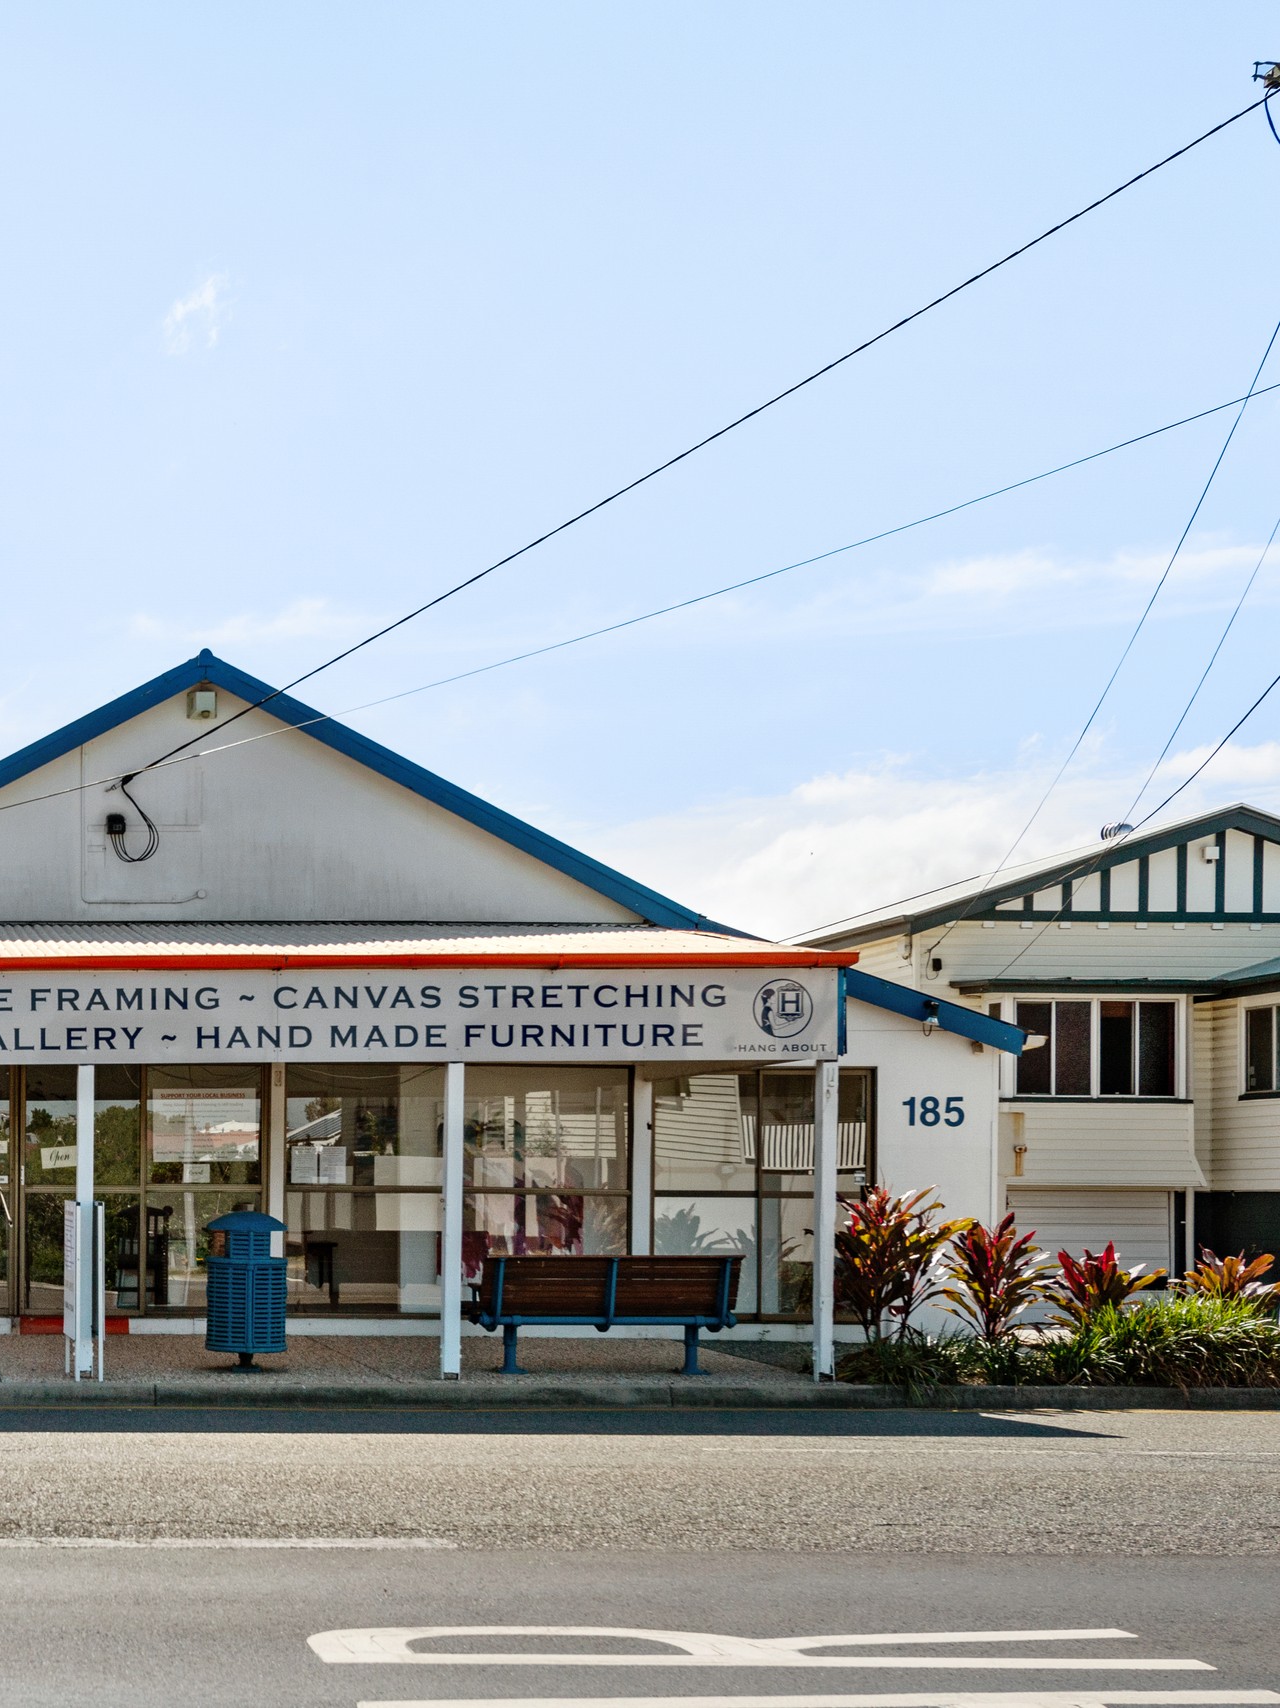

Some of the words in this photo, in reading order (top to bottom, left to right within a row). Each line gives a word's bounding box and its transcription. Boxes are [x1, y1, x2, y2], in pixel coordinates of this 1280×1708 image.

[30, 986, 220, 1012] FRAMING
[273, 985, 442, 1010] CANVAS
[458, 983, 727, 1009] STRETCHING
[196, 1025, 313, 1049] HAND
[330, 1024, 447, 1048] MADE
[464, 1023, 704, 1048] FURNITURE
[738, 1044, 777, 1053] HANG
[781, 1043, 827, 1053] ABOUT
[901, 1095, 966, 1128] 185
[49, 1148, 70, 1166] Open
